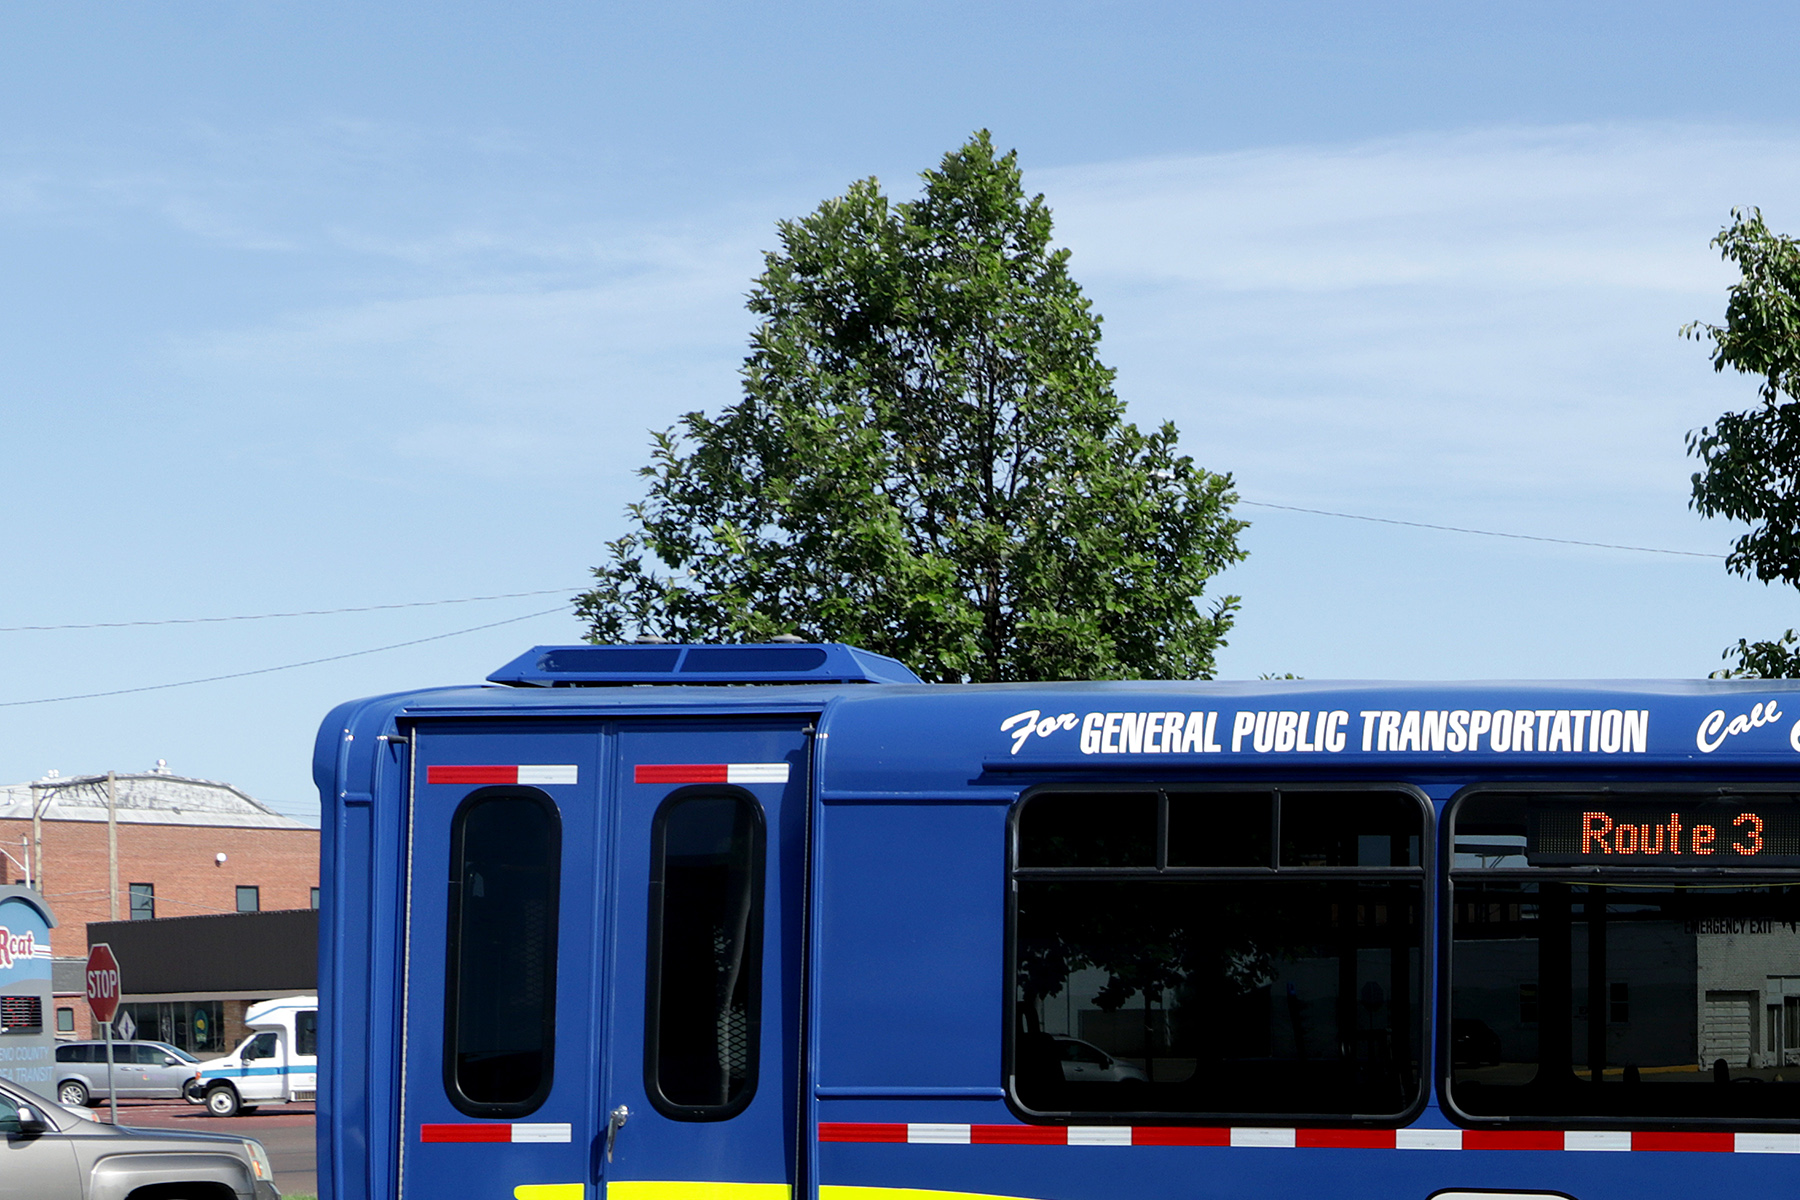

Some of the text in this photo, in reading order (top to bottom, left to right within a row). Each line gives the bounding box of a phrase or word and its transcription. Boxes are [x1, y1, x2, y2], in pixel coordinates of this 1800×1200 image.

[1001, 710, 1080, 755] For
[1080, 712, 1221, 754] GENERAL
[1232, 711, 1348, 752] PUBLIC
[1360, 709, 1648, 752] TRANSPORTATION
[1696, 700, 1782, 753] Call
[1582, 811, 1763, 856] Route 3
[1684, 919, 1772, 934] EMERGENCY EXIT
[88, 970, 117, 999] STOP
[0, 1046, 49, 1061] ENO COUNTY
[16, 1066, 54, 1082] TRANSIT
